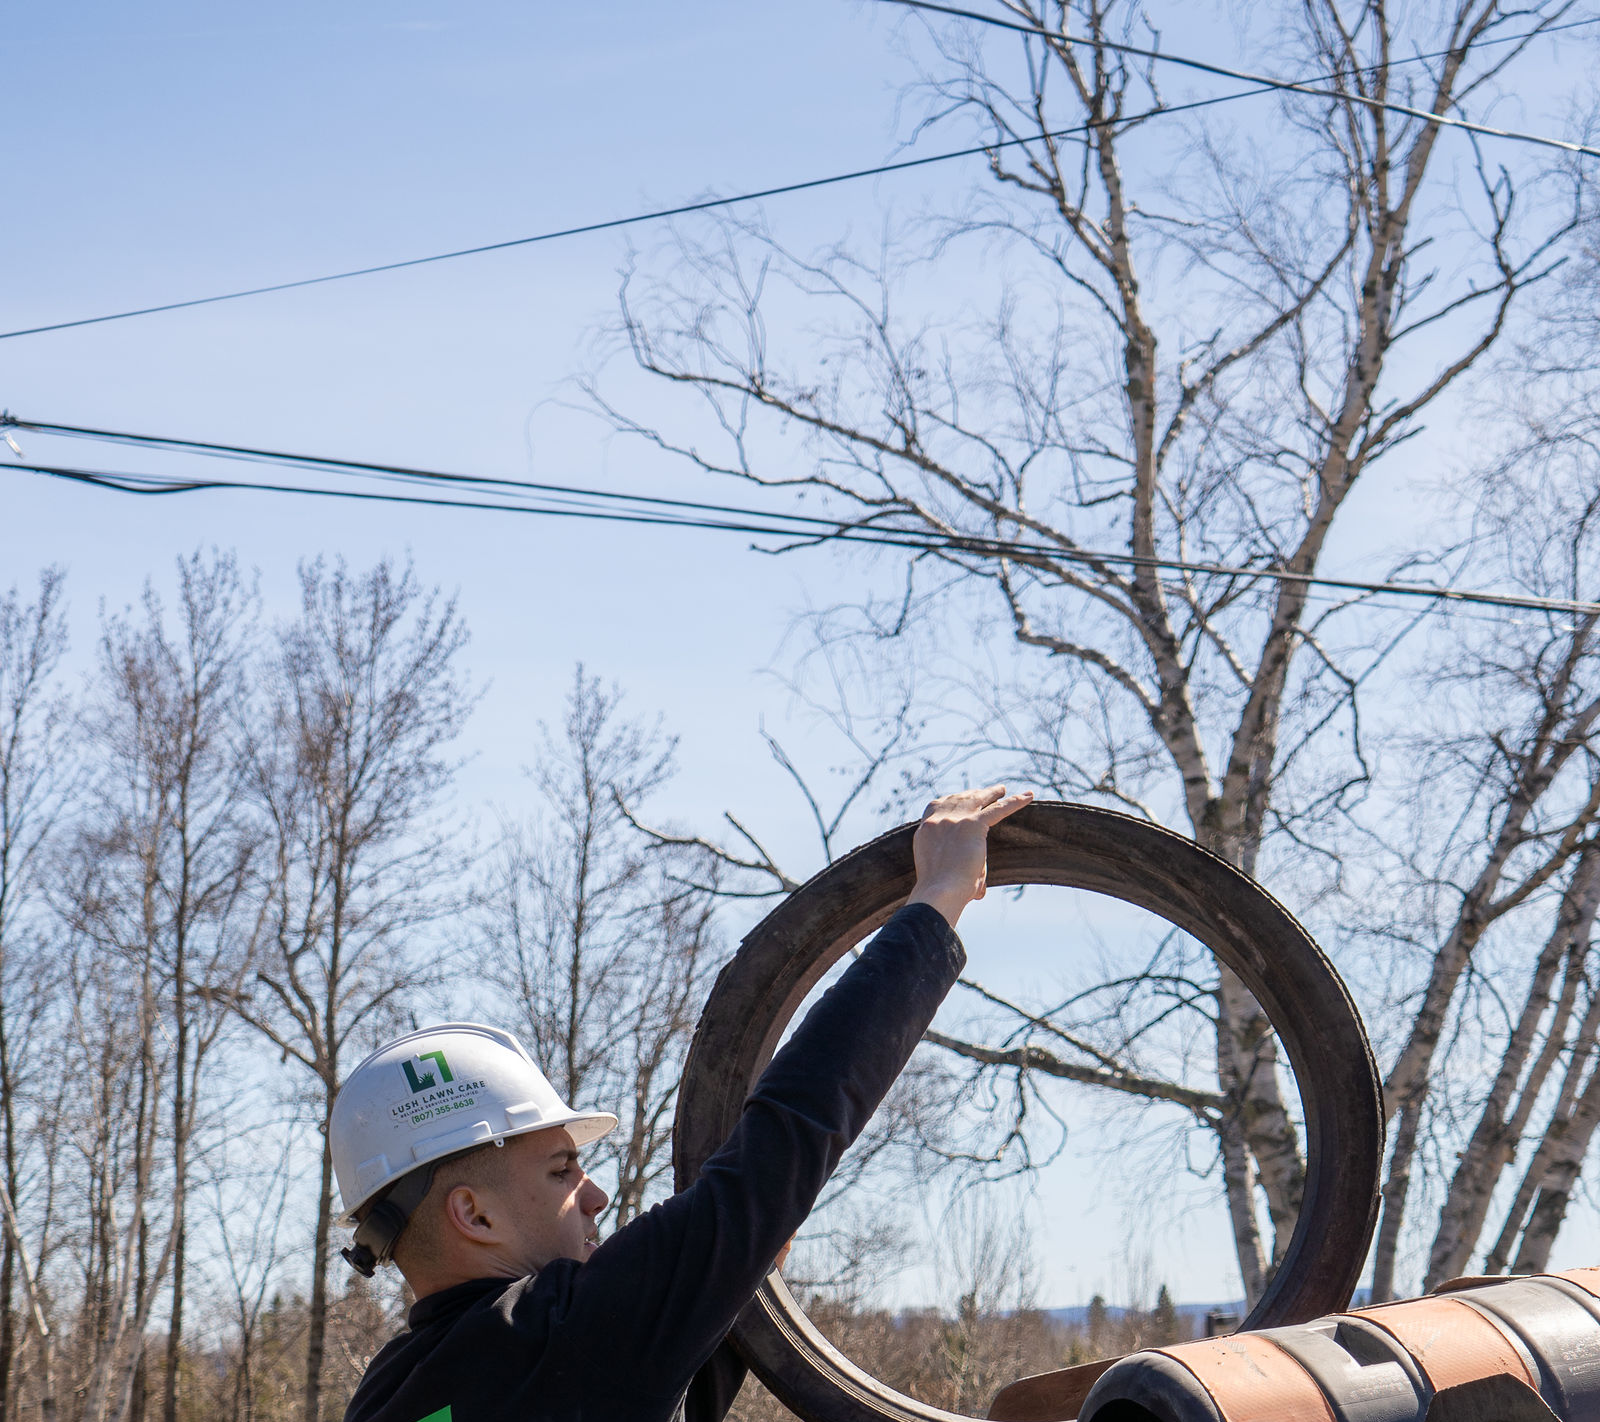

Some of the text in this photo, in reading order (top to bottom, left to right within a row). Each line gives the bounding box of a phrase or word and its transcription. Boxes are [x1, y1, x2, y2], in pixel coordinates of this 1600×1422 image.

[392, 1080, 486, 1116] LUSH LAWN CARE
[411, 1097, 475, 1125] (807) 355-8638
